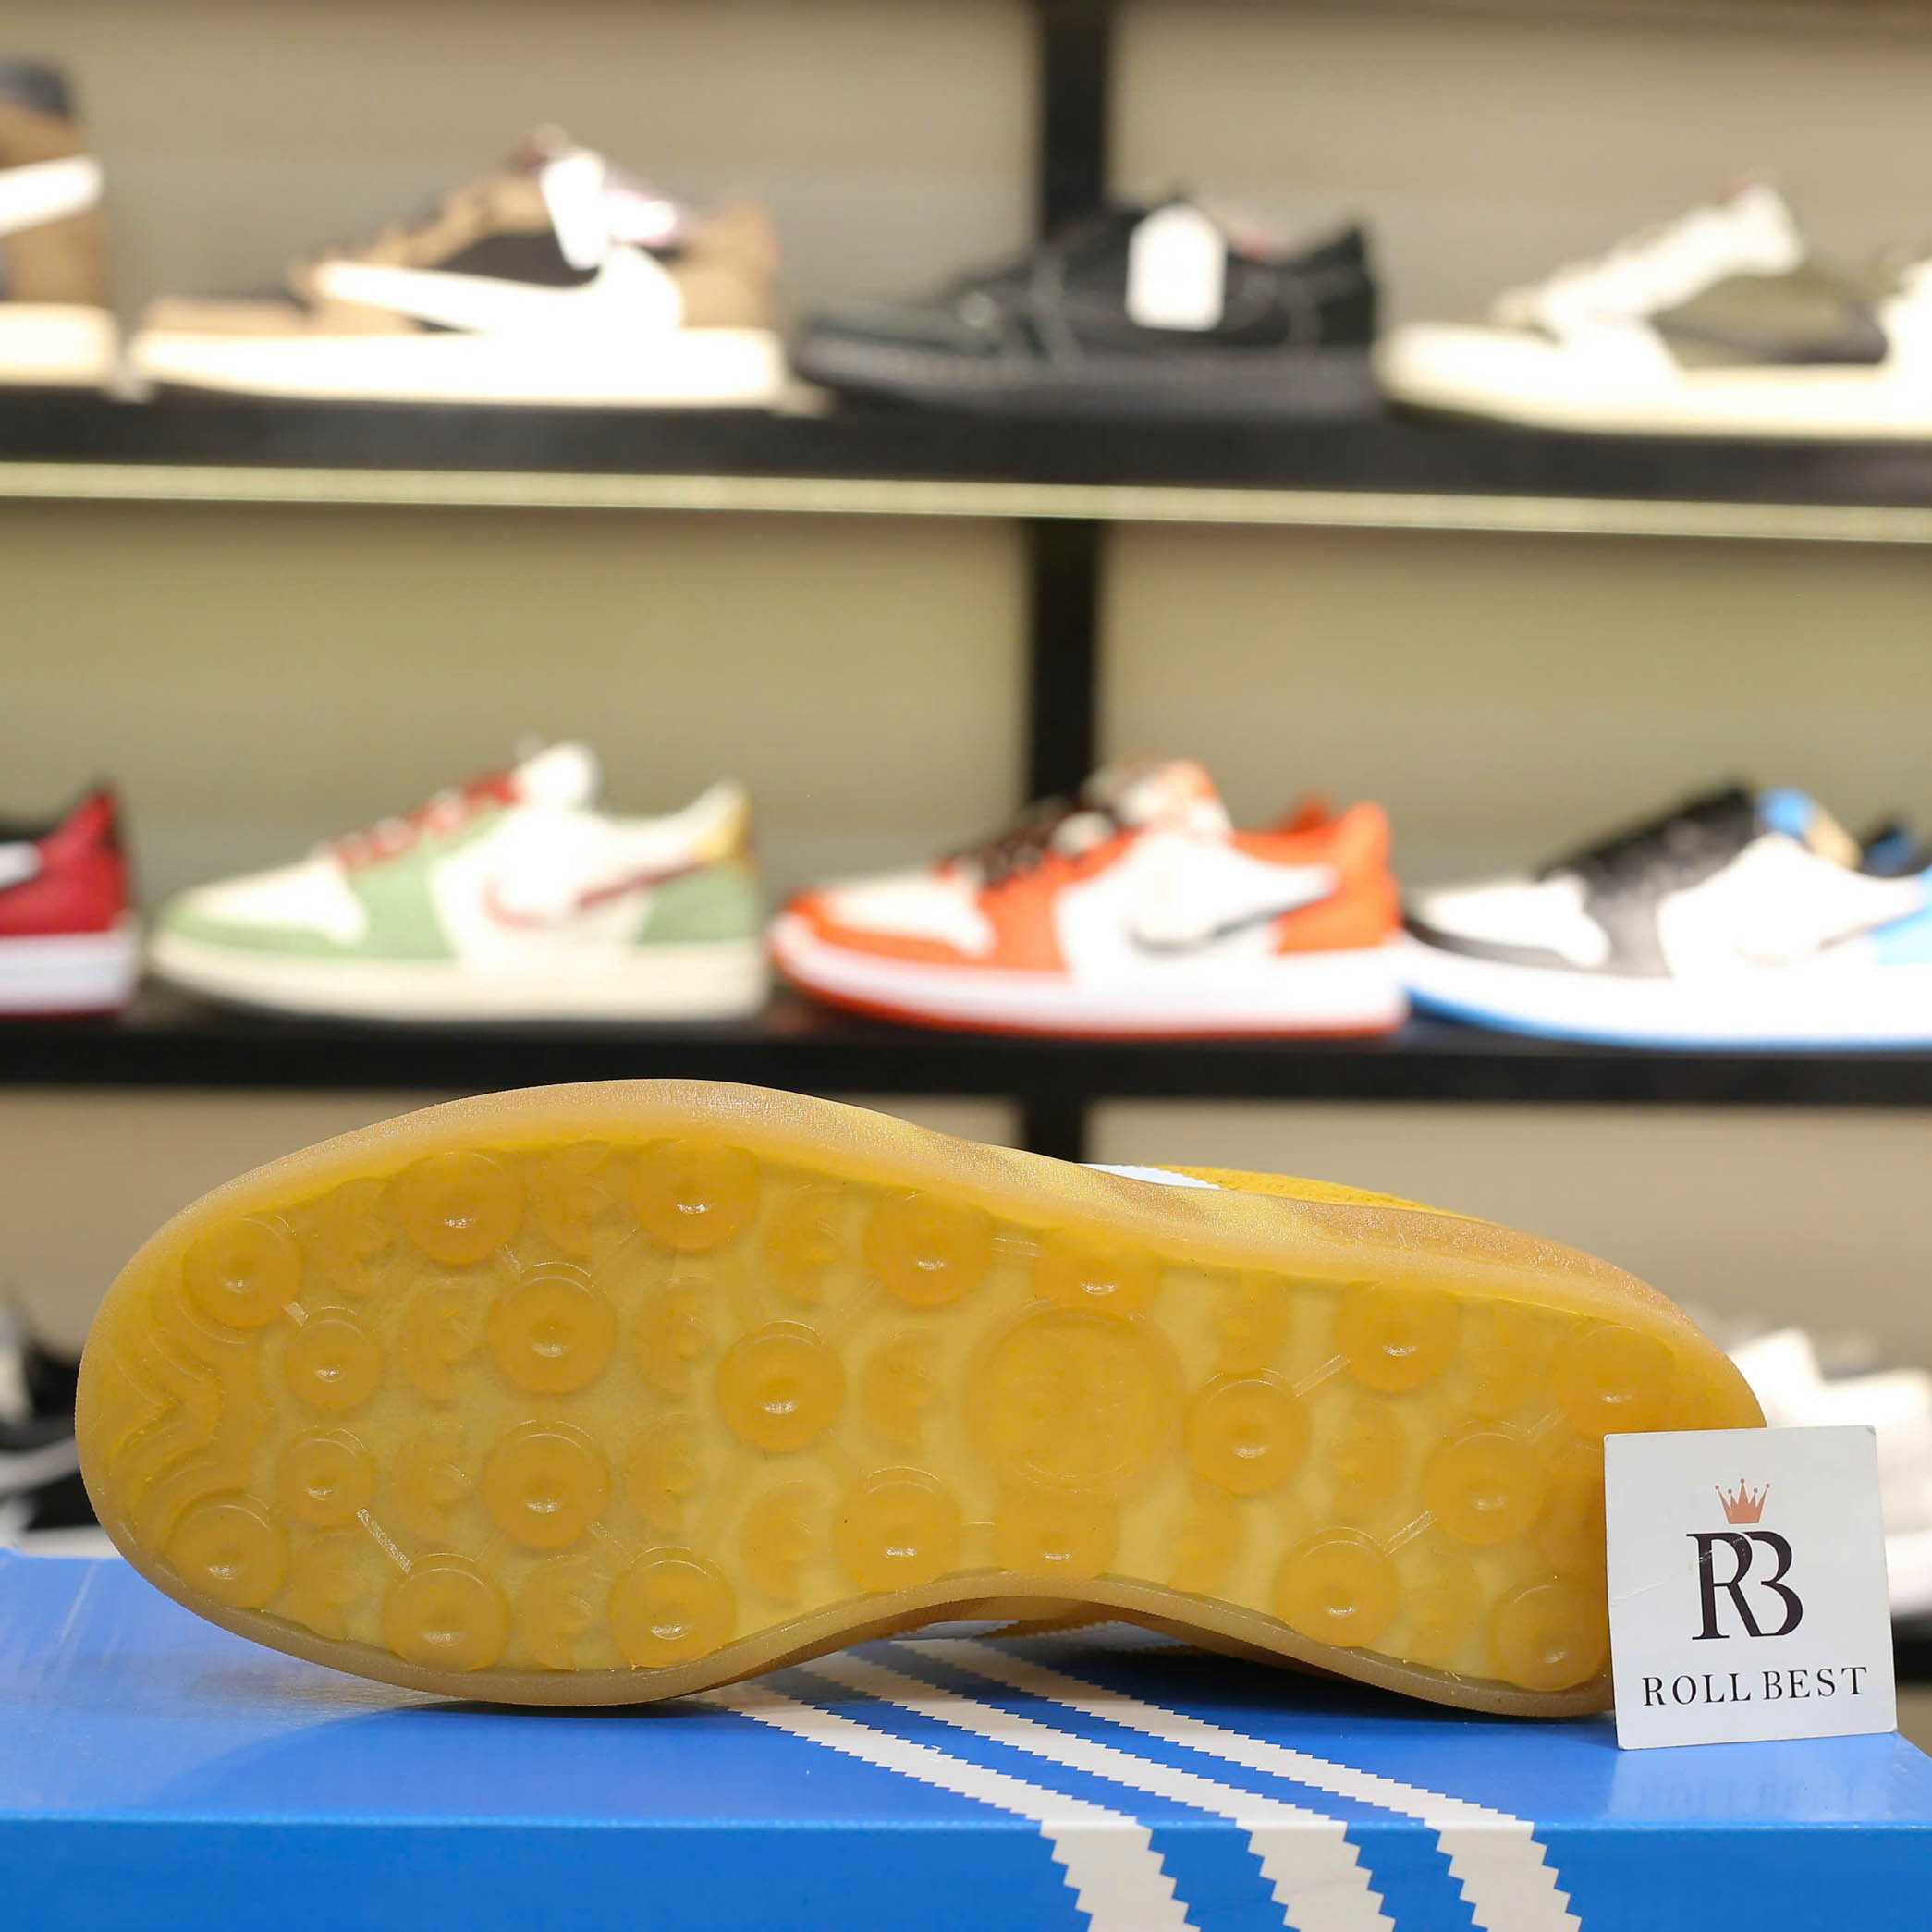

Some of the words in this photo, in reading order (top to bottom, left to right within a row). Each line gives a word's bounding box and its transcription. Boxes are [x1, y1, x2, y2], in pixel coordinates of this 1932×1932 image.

[1686, 1531, 1804, 1640] RB
[1642, 1672, 1752, 1706] ROLL
[1762, 1666, 1867, 1701] BEST
